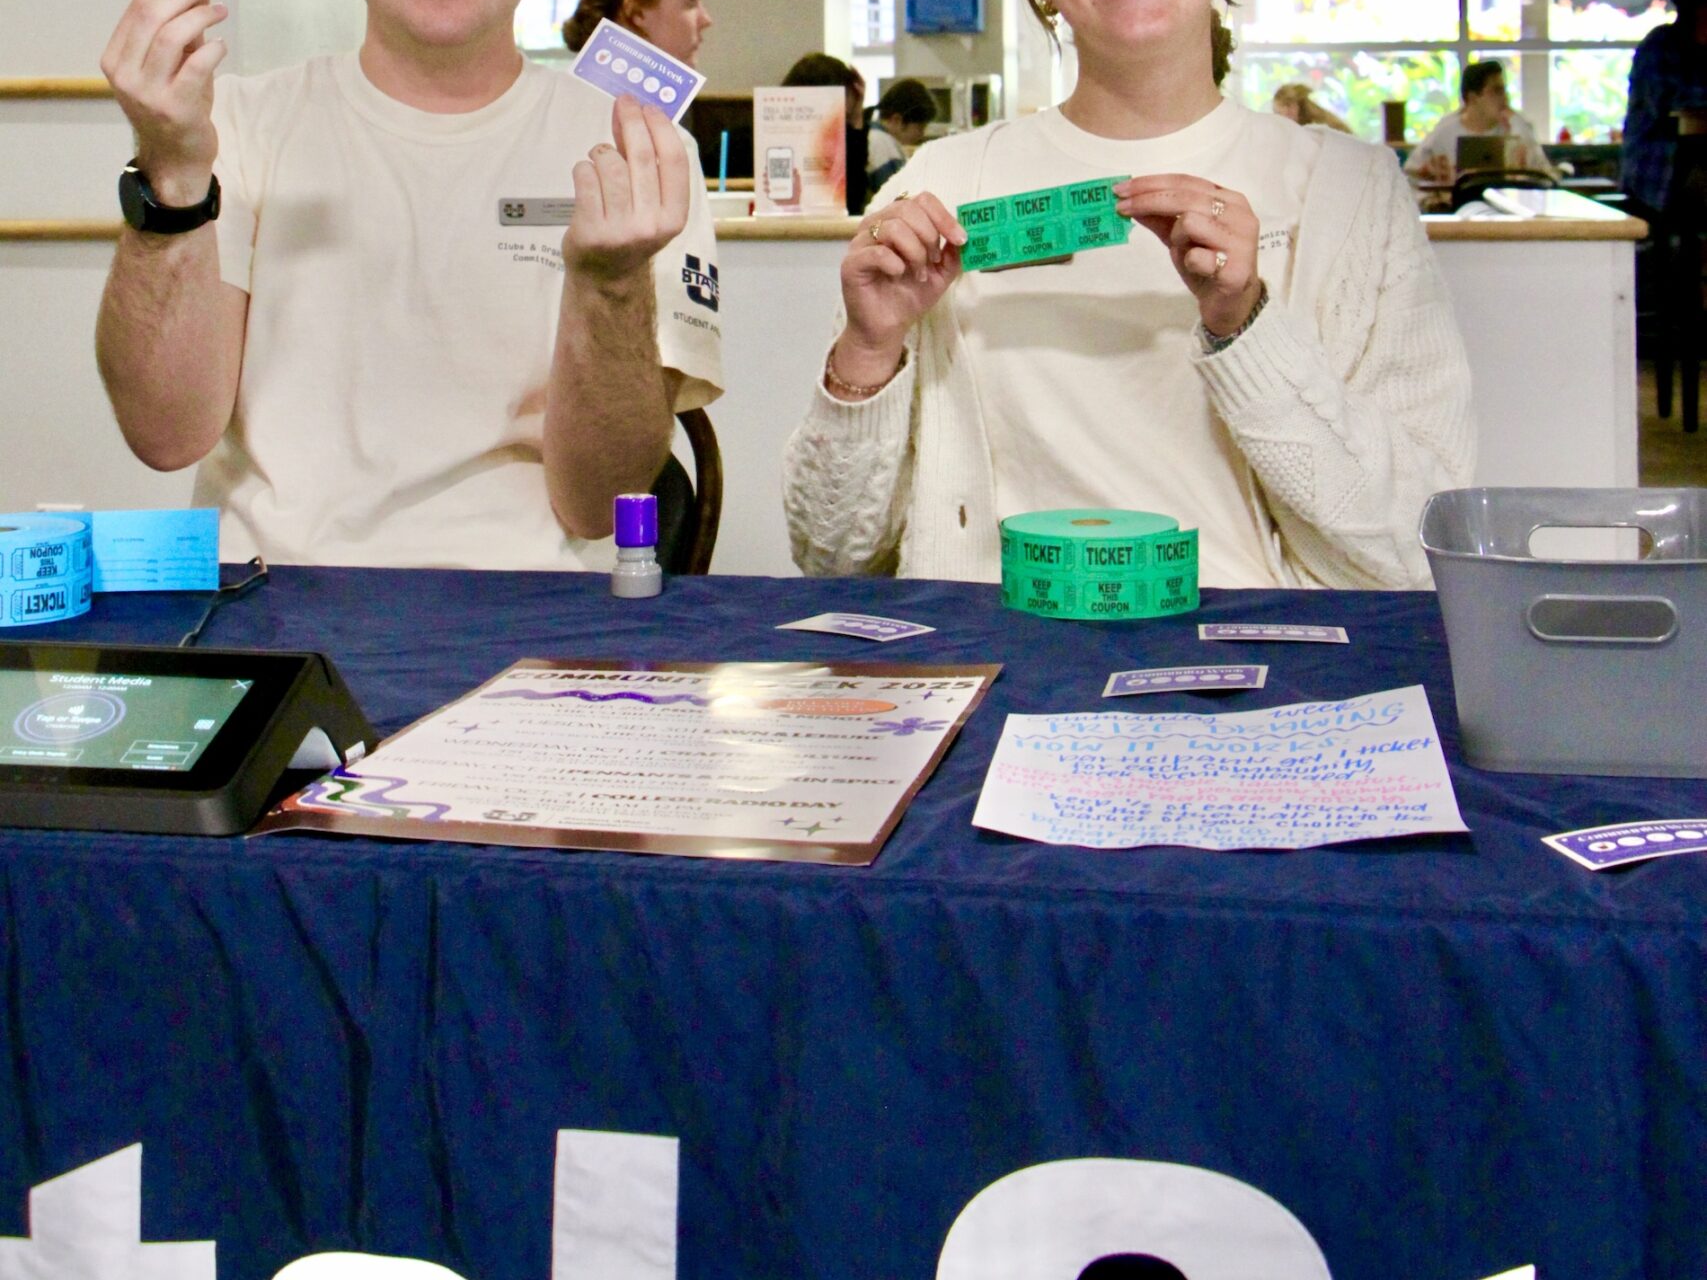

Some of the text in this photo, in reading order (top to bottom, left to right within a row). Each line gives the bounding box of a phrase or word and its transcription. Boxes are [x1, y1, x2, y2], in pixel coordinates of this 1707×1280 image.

[608, 35, 658, 70] Community
[658, 61, 684, 85] Week
[1070, 186, 1108, 206] TICKET
[1015, 196, 1051, 217] TICKET
[961, 206, 996, 226] TICKET
[1082, 217, 1102, 228] KEEP
[1026, 226, 1045, 238] KEEP
[1078, 232, 1110, 245] COUPON
[971, 236, 990, 247] KEEP
[1022, 242, 1053, 255] COUPON
[969, 252, 997, 265] COUPON
[29, 545, 64, 559] COUPON
[1023, 543, 1061, 563] TICKET
[1086, 547, 1133, 566] TICKET
[1156, 541, 1190, 562] TICKET
[36, 565, 58, 577] KEEP
[1032, 579, 1052, 589] KEEP
[1098, 583, 1122, 593] KEEP
[1166, 577, 1184, 588] KEEP
[25, 590, 65, 615] TICKET
[1102, 593, 1119, 602] THIS
[1160, 596, 1188, 609] COUPON
[1027, 598, 1059, 611] COUPON
[1091, 602, 1130, 612] COUPON
[50, 674, 152, 686] Student Media
[507, 672, 715, 685] COMMUNIT
[877, 681, 976, 689] 2025
[1270, 698, 1373, 718] week
[1050, 702, 1405, 733] PRIZE DRAWING
[703, 729, 768, 737] LAWN
[1016, 740, 1104, 752] HOW
[1128, 740, 1167, 752] IT
[1280, 753, 1323, 767] get
[1359, 737, 1433, 755] ticket
[568, 769, 693, 778] PENNANTS
[1072, 761, 1107, 773] for
[1126, 762, 1190, 772] each
[1149, 770, 1219, 780] event
[591, 793, 702, 802] COLLEGE
[704, 797, 786, 807] RADIO
[789, 800, 844, 808] DAY
[1050, 793, 1112, 807] keep
[1165, 802, 1191, 810] of
[1203, 803, 1267, 811] each
[1376, 803, 1428, 812] and
[1060, 810, 1145, 822] basket
[1202, 819, 1261, 827] your
[1275, 820, 1363, 828] choice
[1112, 806, 1152, 815] the
[1162, 810, 1240, 819] other
[1250, 811, 1315, 820] half
[1325, 812, 1378, 821] into
[1388, 812, 1434, 821] the
